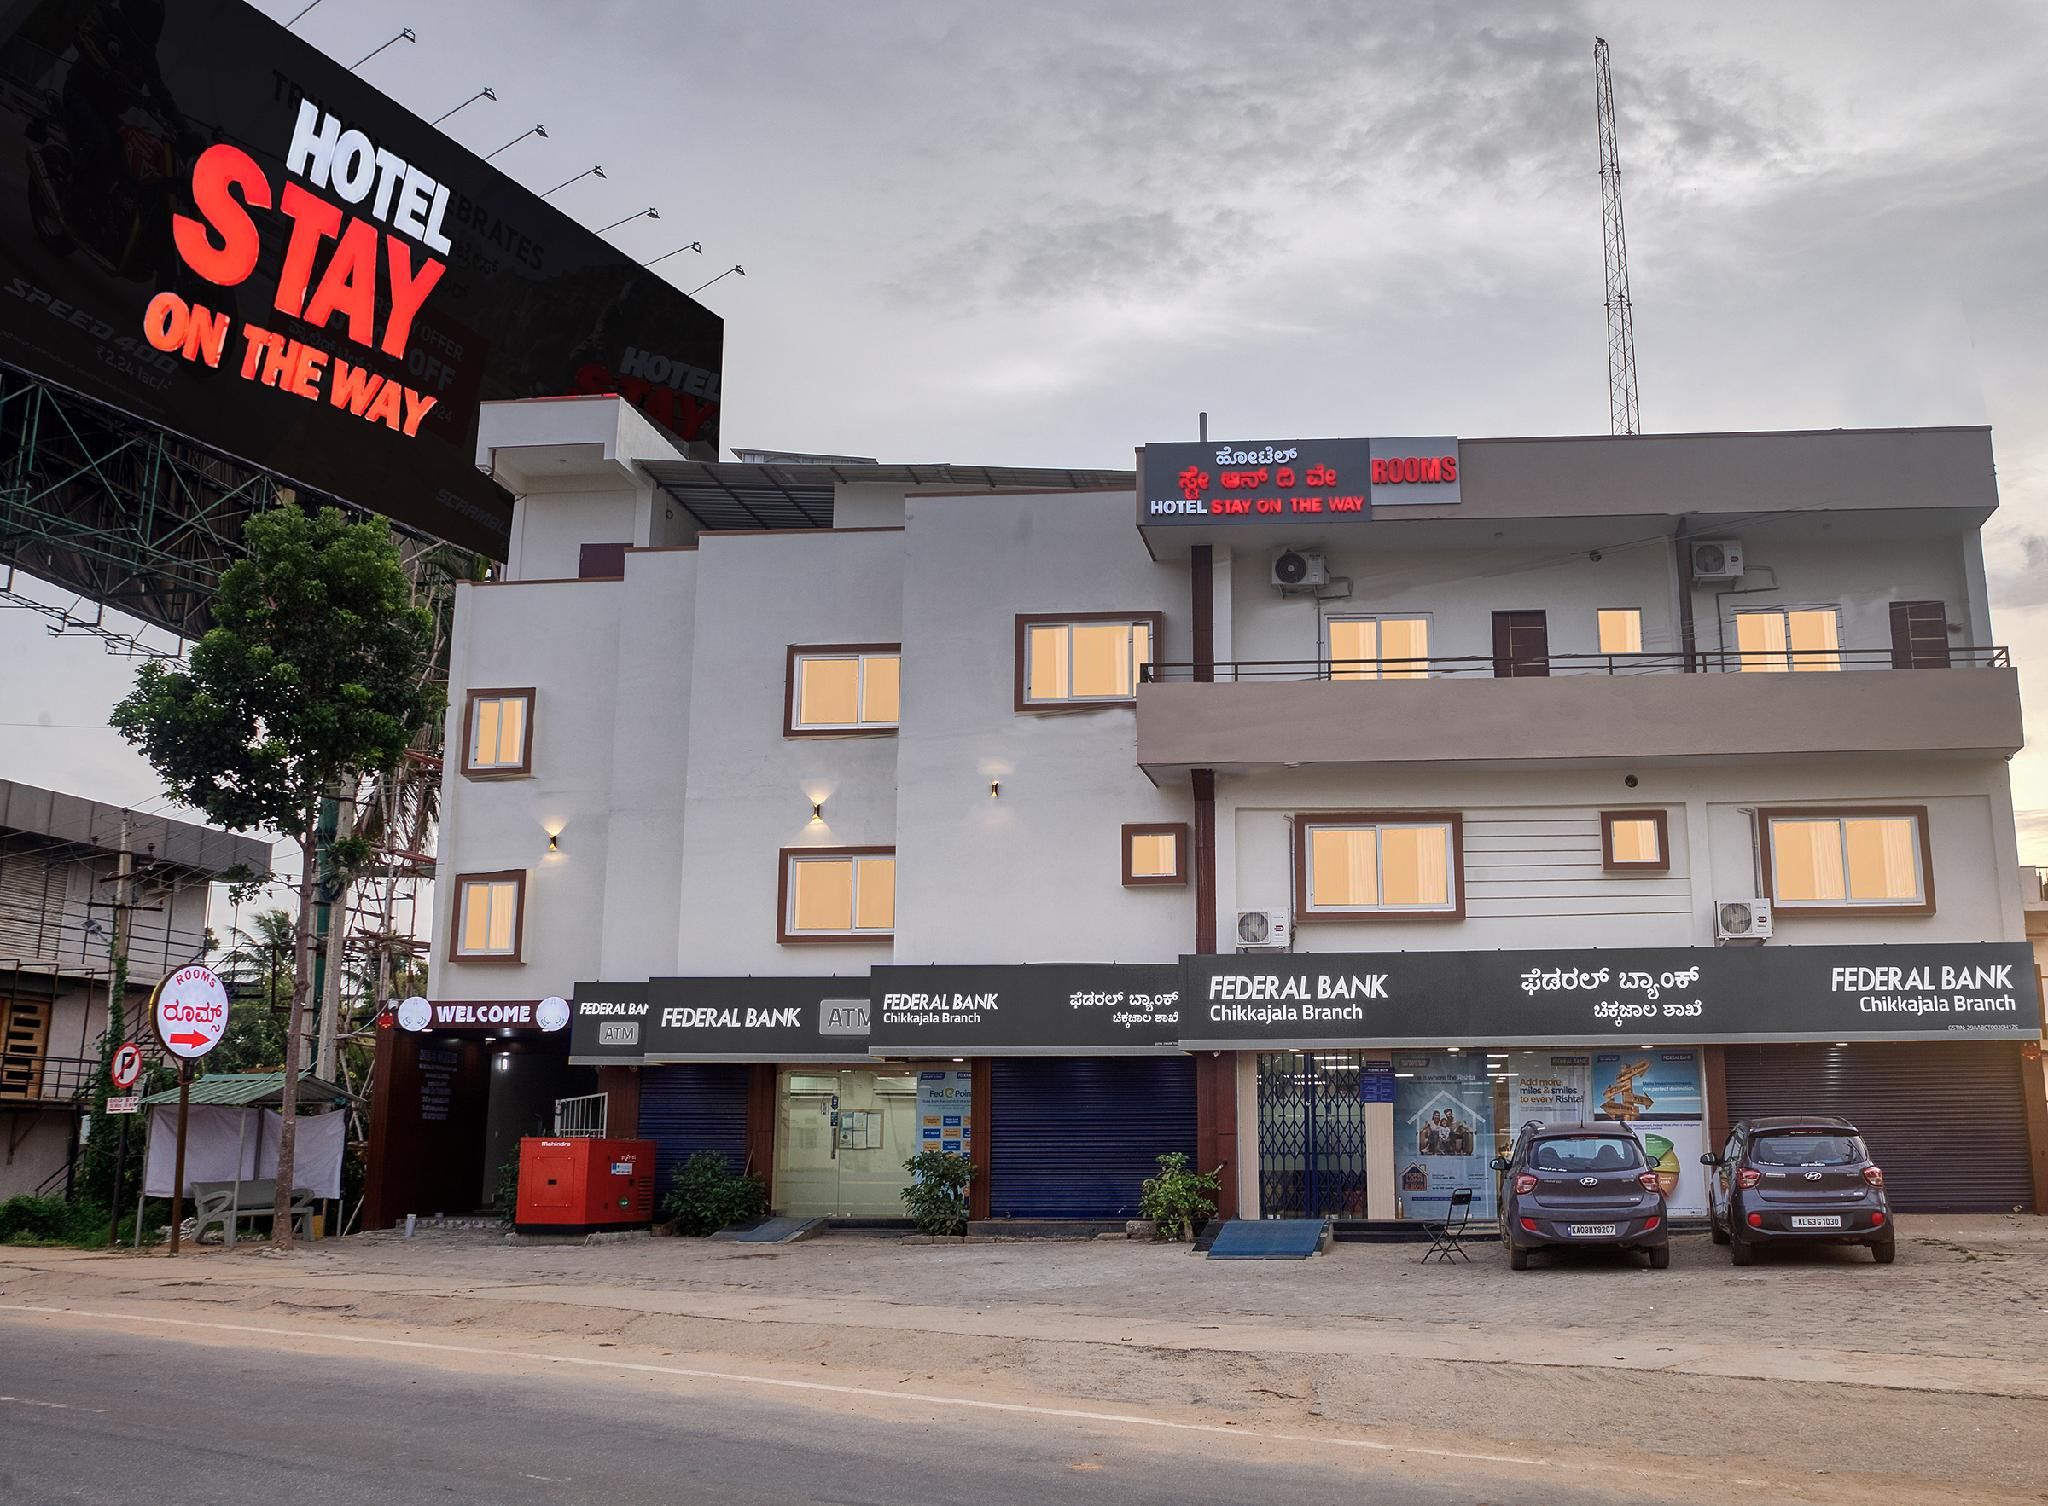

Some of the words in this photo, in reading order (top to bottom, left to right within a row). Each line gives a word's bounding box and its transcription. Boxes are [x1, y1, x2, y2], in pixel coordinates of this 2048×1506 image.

[285, 97, 452, 257] HOTEL
[173, 143, 446, 361] STAY
[3, 277, 115, 341] SPEED
[113, 336, 179, 374] 400
[422, 325, 464, 361] OFFER
[143, 291, 231, 369] ON
[241, 322, 330, 402] THE
[329, 356, 439, 438] WAY
[408, 347, 456, 391] OFF
[619, 346, 721, 404] HOTEL
[1215, 446, 1298, 466] ಹೋಟೆಲ್
[1178, 464, 1210, 500] ಸ್ಟೇ
[1220, 466, 1269, 490] ಆನ್
[1275, 465, 1296, 489] ದಿ
[1305, 463, 1338, 488] ವೇ
[1371, 456, 1457, 485] ROOMS
[435, 488, 511, 539] SCRAMBL
[1150, 499, 1208, 515] HOTEL
[1211, 499, 1252, 515] STAY
[1256, 499, 1283, 514] ON
[1290, 497, 1324, 513] THE
[1329, 495, 1365, 513] WAY
[176, 969, 217, 989] ROOMS
[1209, 975, 1311, 1000] FEDERAL
[1317, 974, 1389, 999] BANK
[1520, 967, 1610, 996] ಫೆಡರಲ್
[1618, 965, 1700, 1000] ಬ್ಯಾಂಕ್
[1831, 966, 1936, 992] FEDERAL
[1941, 964, 2014, 990] BANK
[579, 1002, 626, 1016] FEDERAL
[883, 993, 950, 1011] FEDERAL
[952, 993, 999, 1010] BANK
[1069, 991, 1124, 1009] ಫೆಡರಲ್
[1128, 991, 1179, 1012] ಬ್ಯಾಂಕ್
[1859, 995, 1950, 1017] Chikkajala
[1954, 994, 2017, 1012] Branch
[163, 1000, 223, 1033] ರೂಮ್ಸ್
[436, 1005, 531, 1023] WELCOME
[660, 1008, 741, 1028] FEDERAL
[745, 1008, 802, 1028] BANK
[828, 1008, 871, 1028] ATM
[883, 1012, 940, 1026] Chikkajala
[942, 1012, 981, 1023] Branch
[1112, 1011, 1151, 1029] ಚಿಕ್ಕಜಾಲ
[1210, 1004, 1298, 1025] Chikkajala
[1302, 1003, 1363, 1021] Branch
[1593, 1001, 1657, 1027] ಚಿಕ್ಕಜಾಲ
[1663, 1000, 1702, 1017] ಶಾಖೆ
[604, 1027, 634, 1040] ATM
[1520, 1078, 1537, 1086] Add
[1520, 1086, 1542, 1094] miles
[1551, 1086, 1577, 1094] smiles
[929, 1089, 944, 1098] Fed
[1530, 1096, 1554, 1104] every
